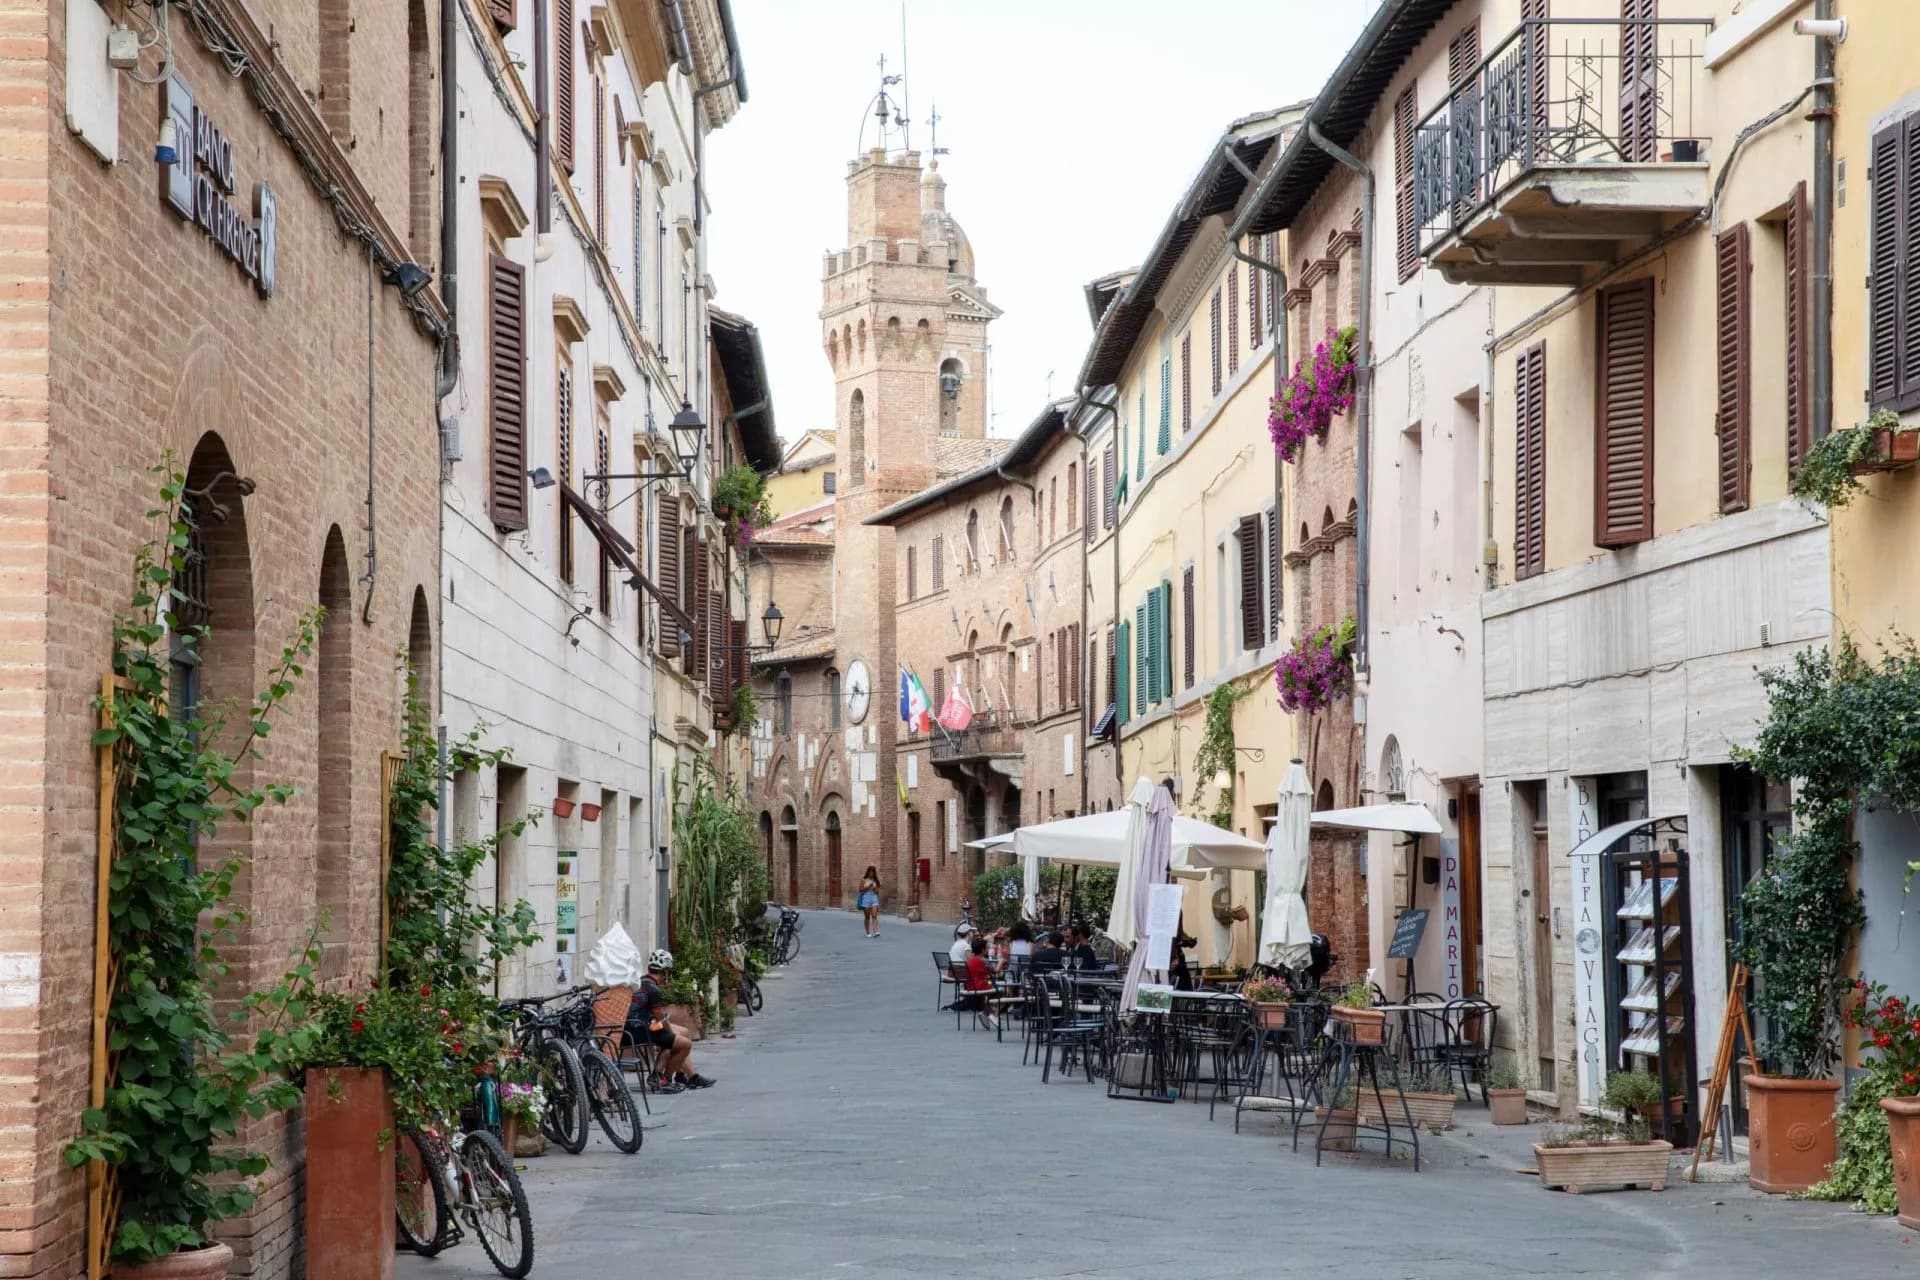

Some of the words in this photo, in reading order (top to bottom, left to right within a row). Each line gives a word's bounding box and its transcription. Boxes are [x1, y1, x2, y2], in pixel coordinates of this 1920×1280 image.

[196, 107, 235, 194] BANCA
[197, 174, 214, 234] CR
[217, 196, 257, 278] FIRENZE
[1445, 857, 1457, 891] DA
[1446, 906, 1459, 998] MARIO
